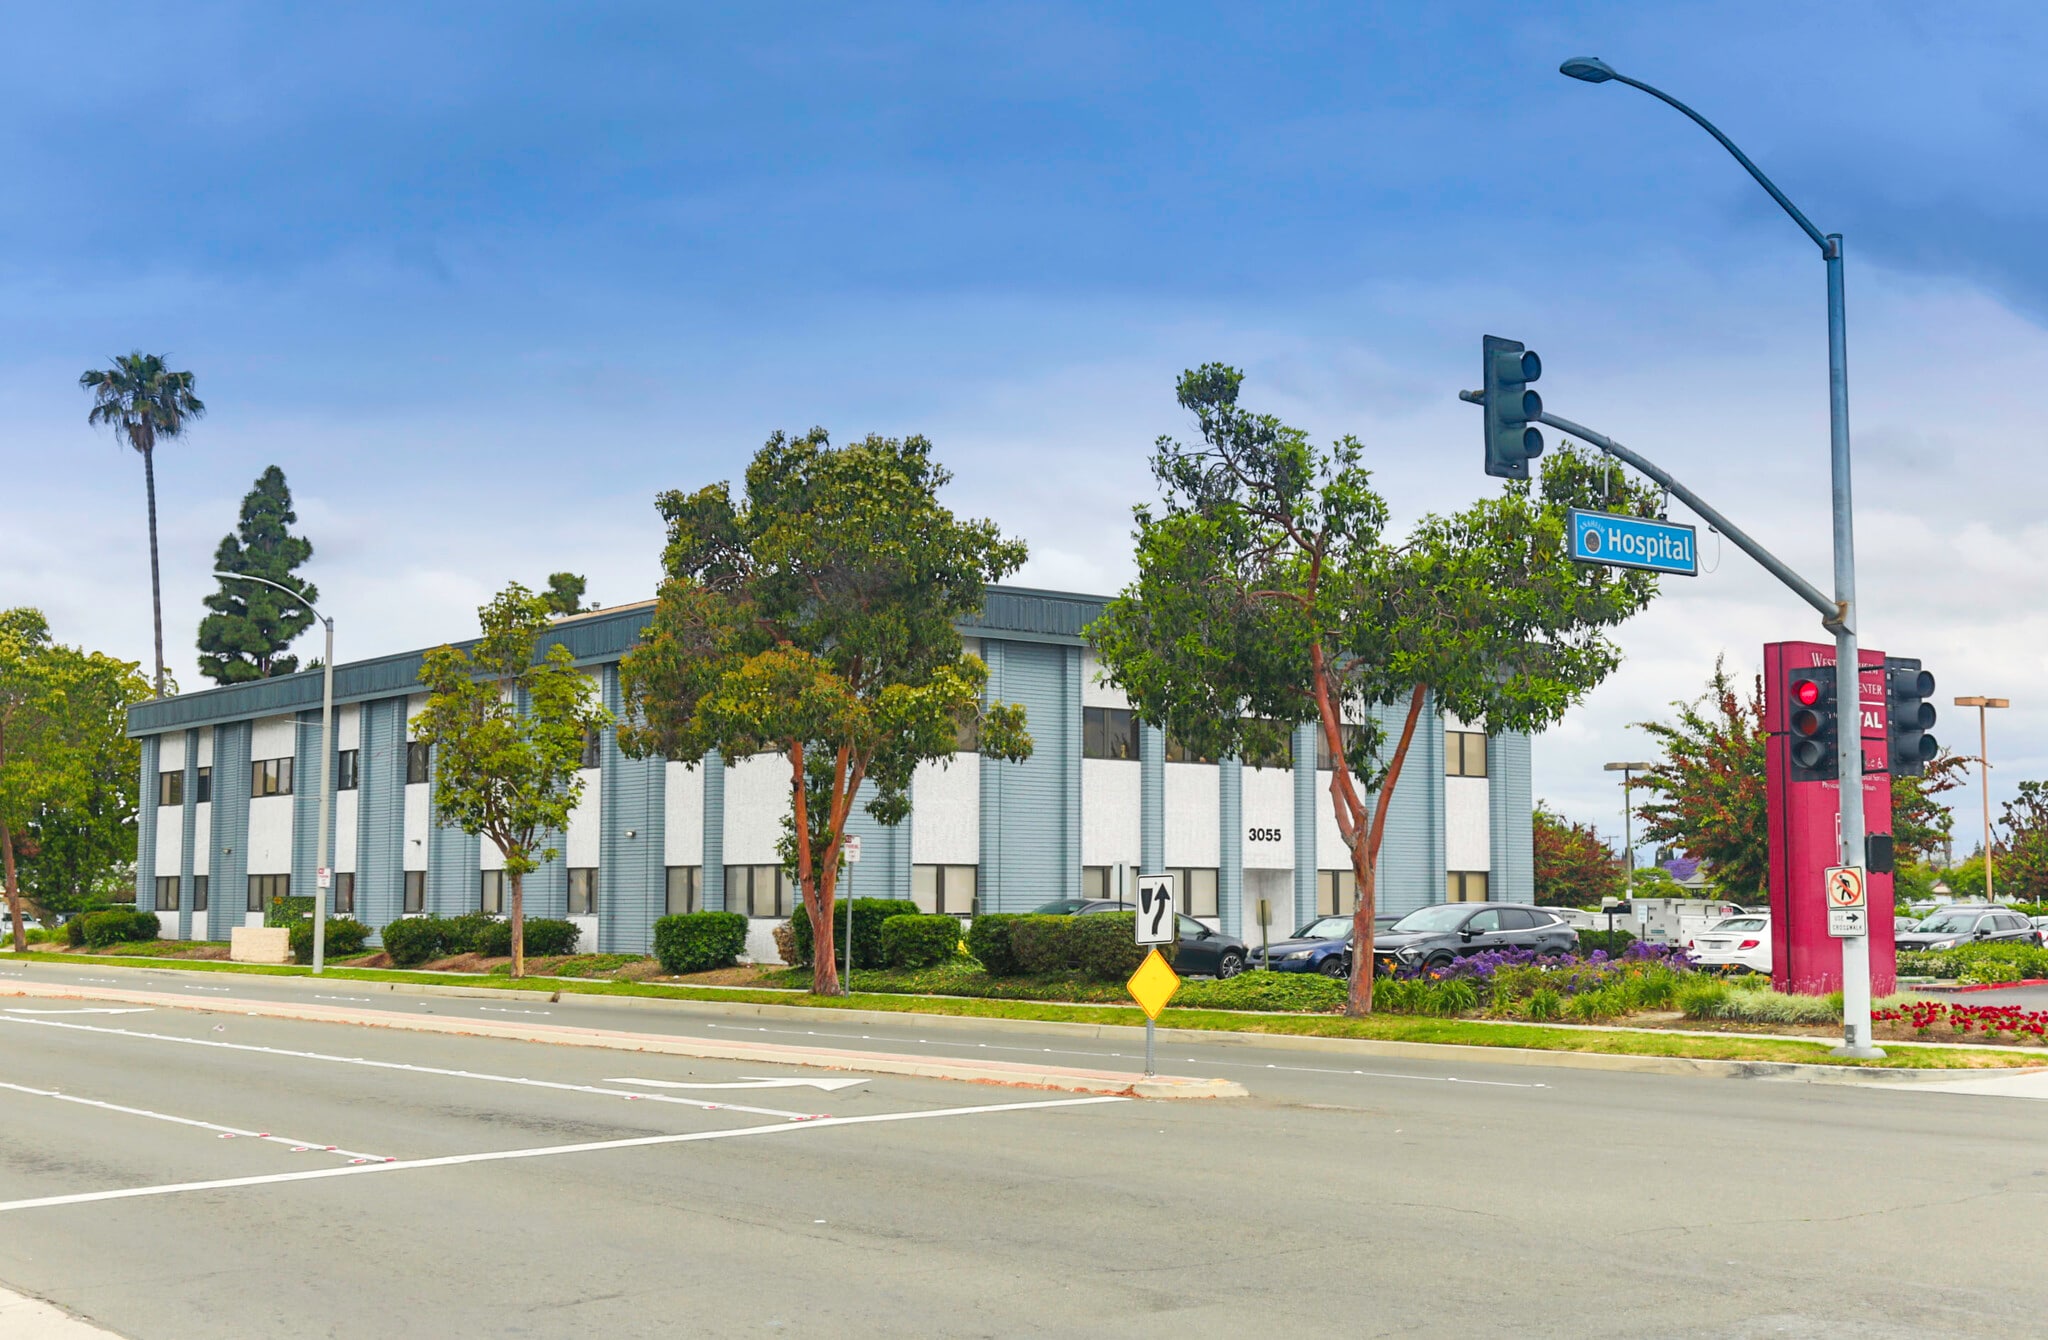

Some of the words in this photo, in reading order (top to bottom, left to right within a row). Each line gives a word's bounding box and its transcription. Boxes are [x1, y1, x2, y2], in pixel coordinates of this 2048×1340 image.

[1608, 527, 1691, 563] Hospital
[1858, 683, 1882, 695] ENTER
[1249, 828, 1281, 841] 3055
